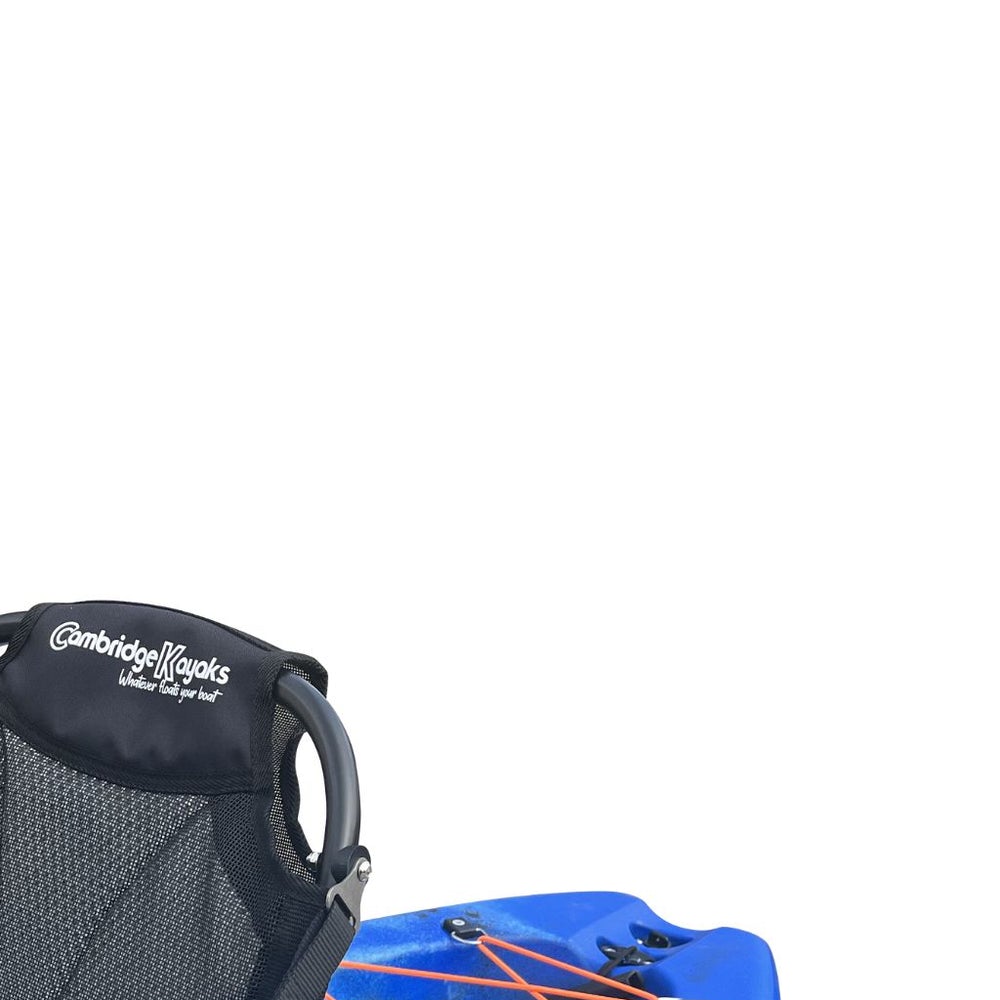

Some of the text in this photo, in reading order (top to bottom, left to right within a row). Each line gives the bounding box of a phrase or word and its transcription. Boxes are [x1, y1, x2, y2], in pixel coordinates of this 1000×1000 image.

[118, 669, 223, 703] Whatever floats your boat
